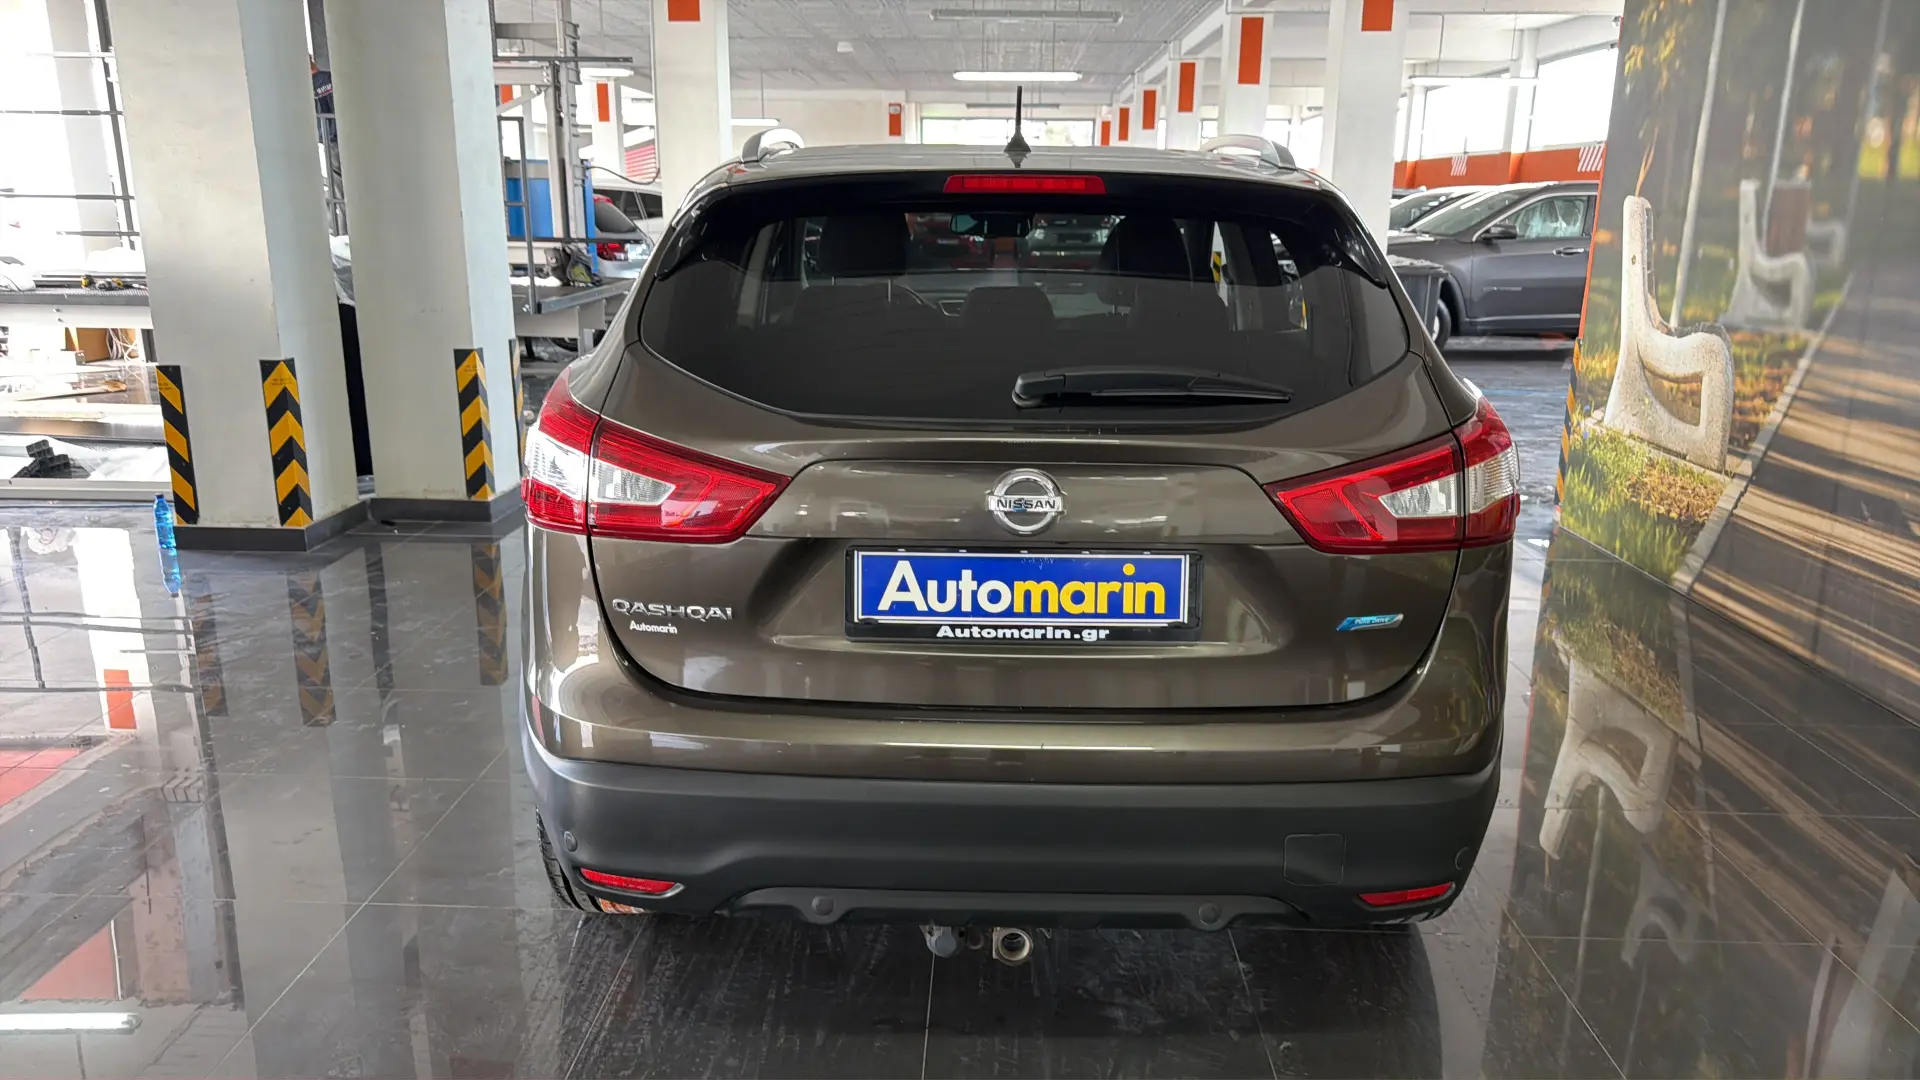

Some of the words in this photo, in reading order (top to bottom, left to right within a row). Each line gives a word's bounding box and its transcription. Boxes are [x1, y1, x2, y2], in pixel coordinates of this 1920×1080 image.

[996, 499, 1056, 509] NISSAN
[877, 559, 1166, 615] Automarin
[612, 598, 733, 622] QASHQAI
[629, 620, 678, 634] Automarin
[936, 625, 1110, 642] Automarin.gr
